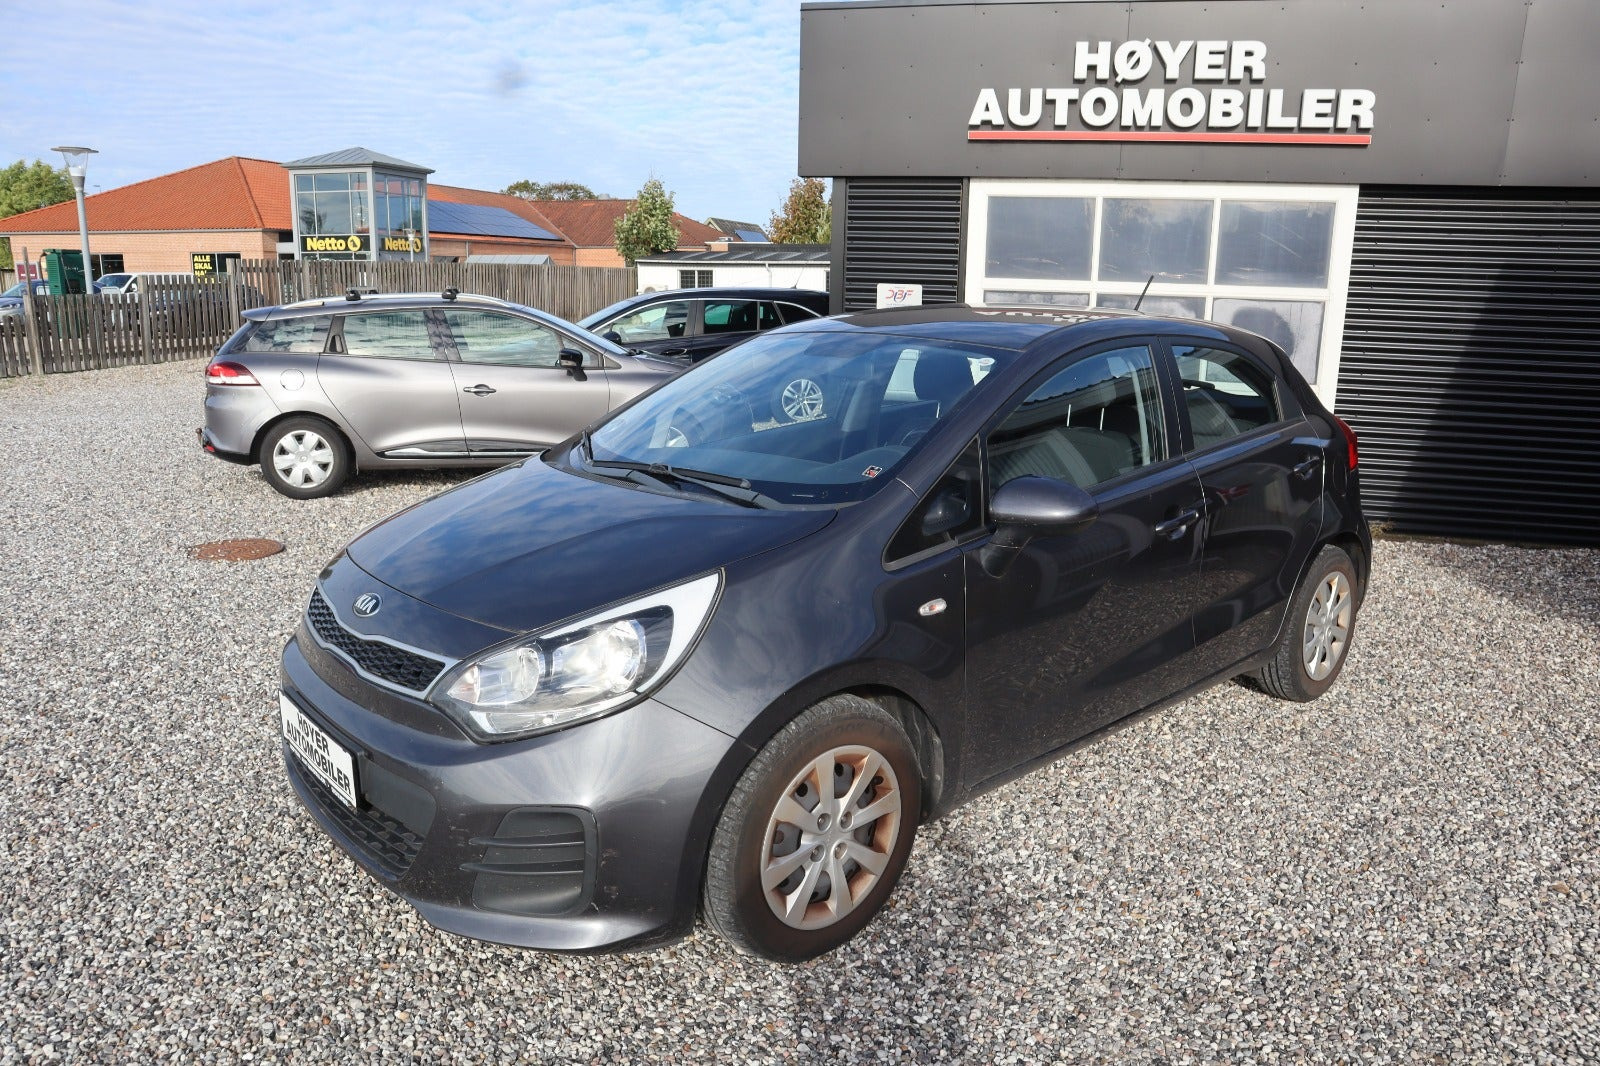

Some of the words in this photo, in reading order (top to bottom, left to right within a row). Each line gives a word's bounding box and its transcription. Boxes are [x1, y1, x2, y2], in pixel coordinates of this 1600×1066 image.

[1074, 38, 1267, 83] HØYER
[968, 87, 1376, 129] AUTOMOBILER
[306, 237, 346, 251] Netto
[286, 719, 352, 795] AUTOMOBILER
